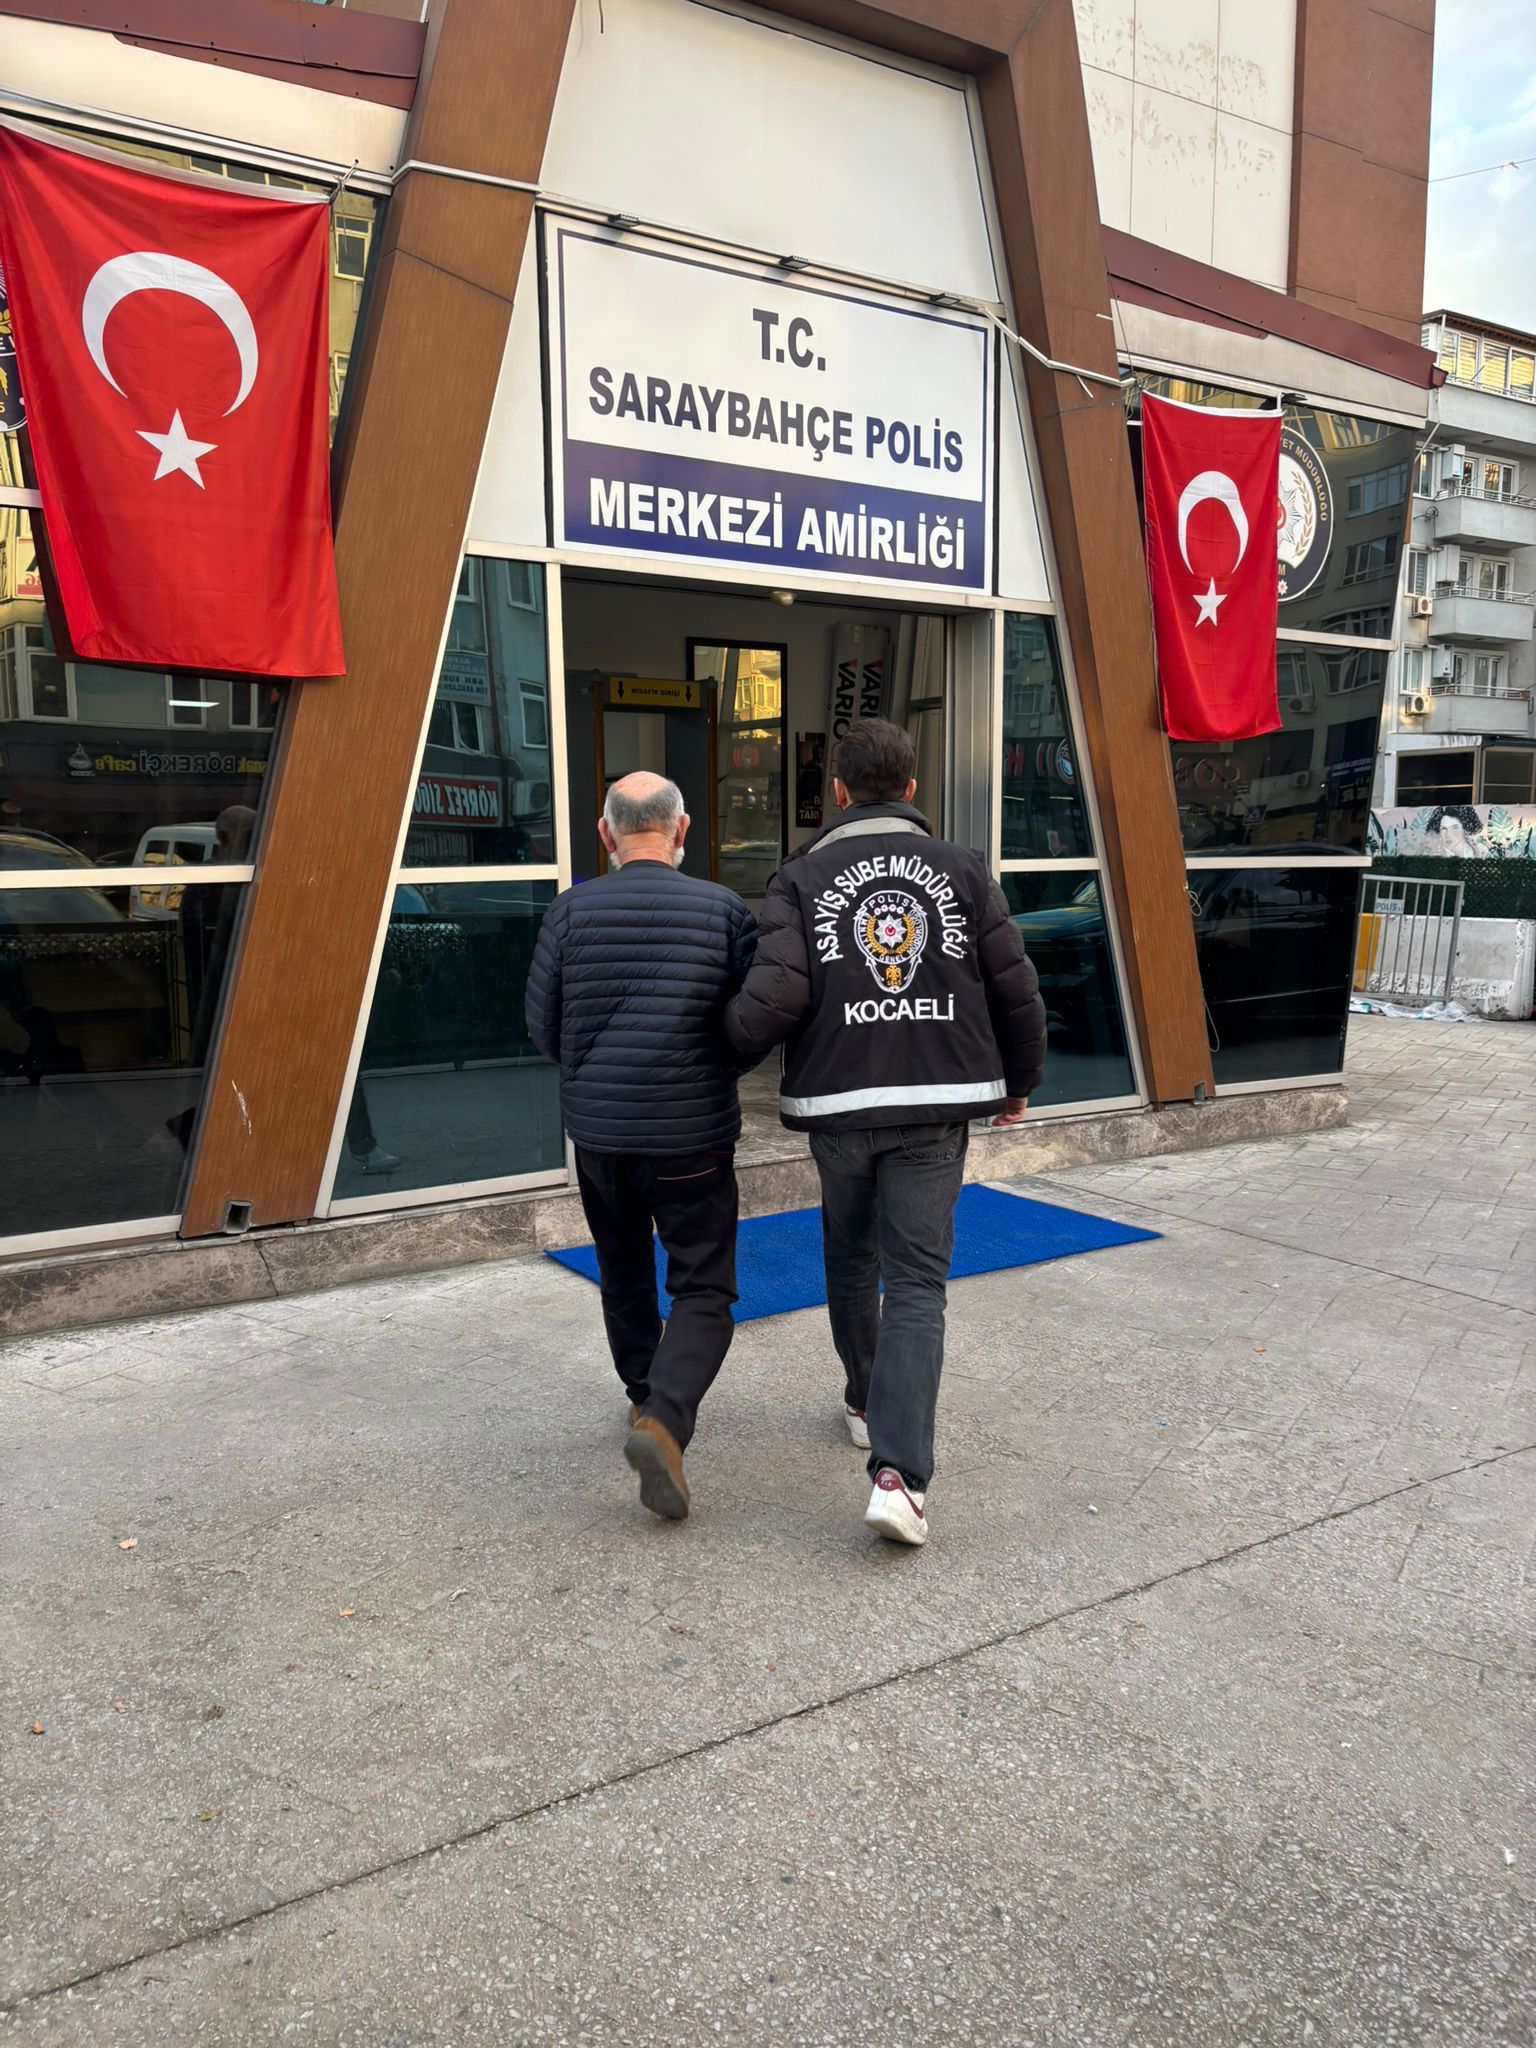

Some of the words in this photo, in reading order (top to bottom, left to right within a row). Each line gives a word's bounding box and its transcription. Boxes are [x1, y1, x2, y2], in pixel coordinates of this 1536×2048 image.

[752, 308, 826, 371] T.C.
[589, 366, 854, 462] SARAYBAHÇE
[866, 417, 964, 473] POLİS
[1295, 445, 1329, 522] MÜDÜRLÜĞÜ
[589, 477, 784, 549] MERKEZİ
[796, 503, 965, 571] AMİRLİĞİ
[813, 889, 849, 964] ASAYİŞ
[834, 855, 888, 898] ŞUBE
[889, 855, 968, 960] MÜDÜRLÜĞÜ
[868, 894, 910, 909] POLİS
[844, 993, 955, 1025] KOCAELİ
